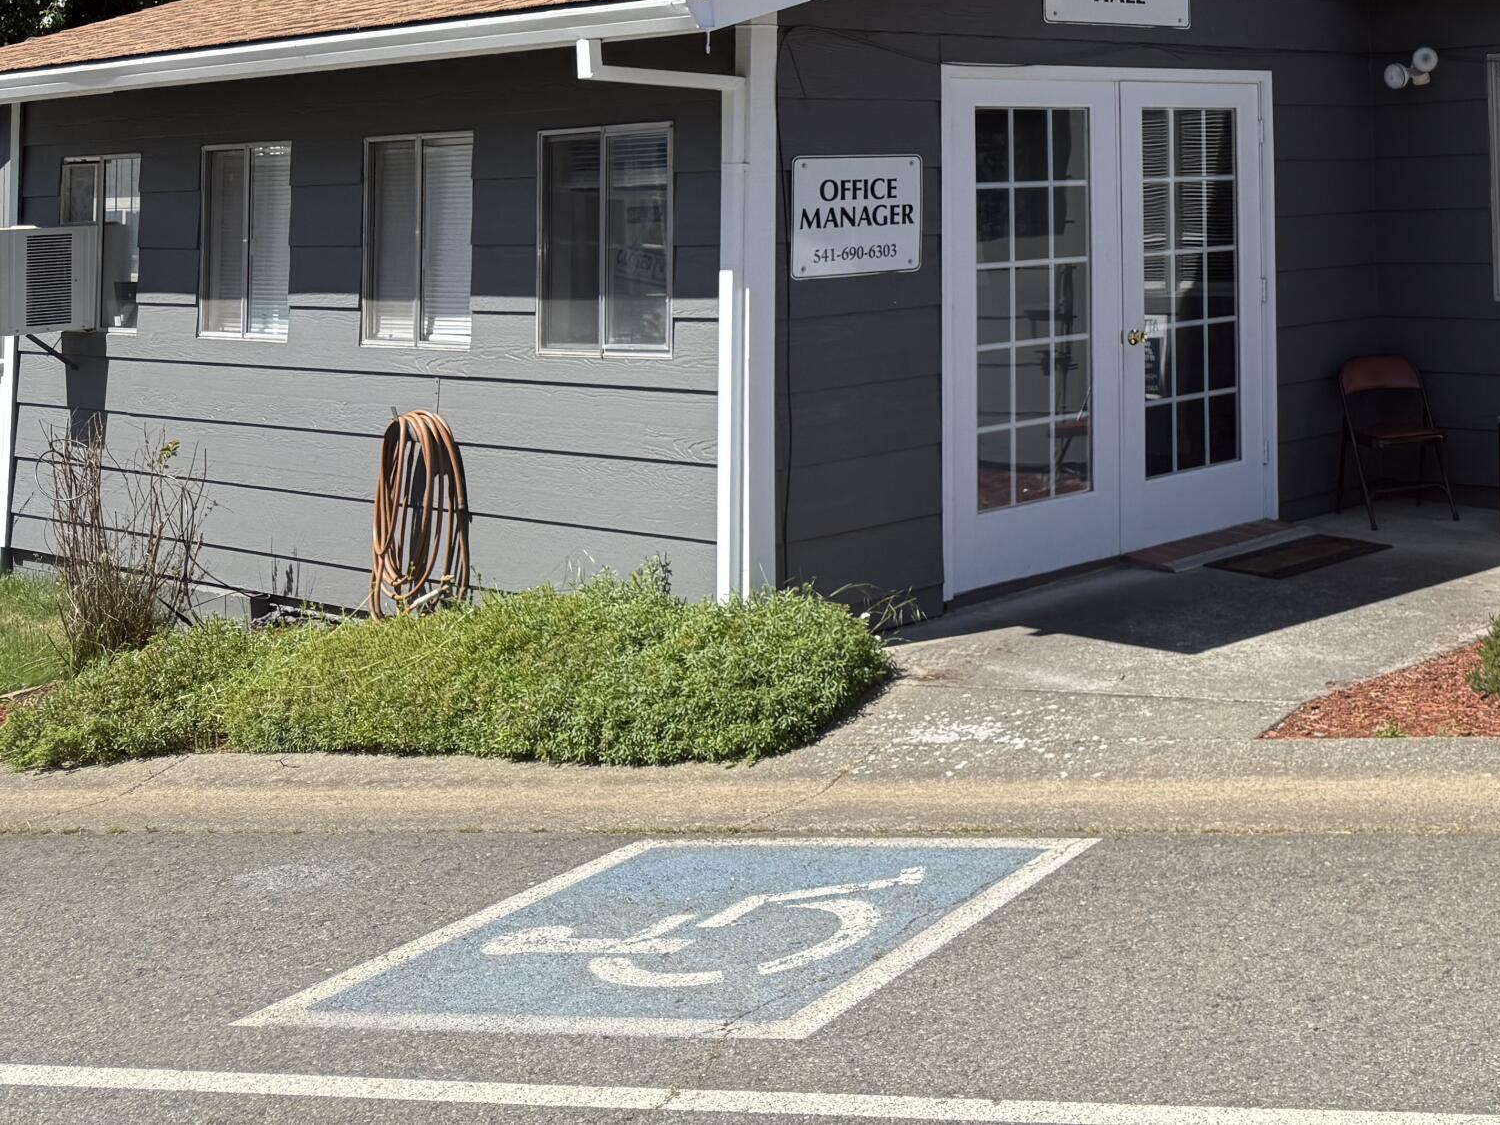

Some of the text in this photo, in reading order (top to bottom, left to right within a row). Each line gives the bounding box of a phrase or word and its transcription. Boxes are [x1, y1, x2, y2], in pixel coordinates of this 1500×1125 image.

[819, 177, 898, 202] OFFICE
[799, 203, 914, 230] MANAGER
[813, 243, 898, 264] 541-690-6303
